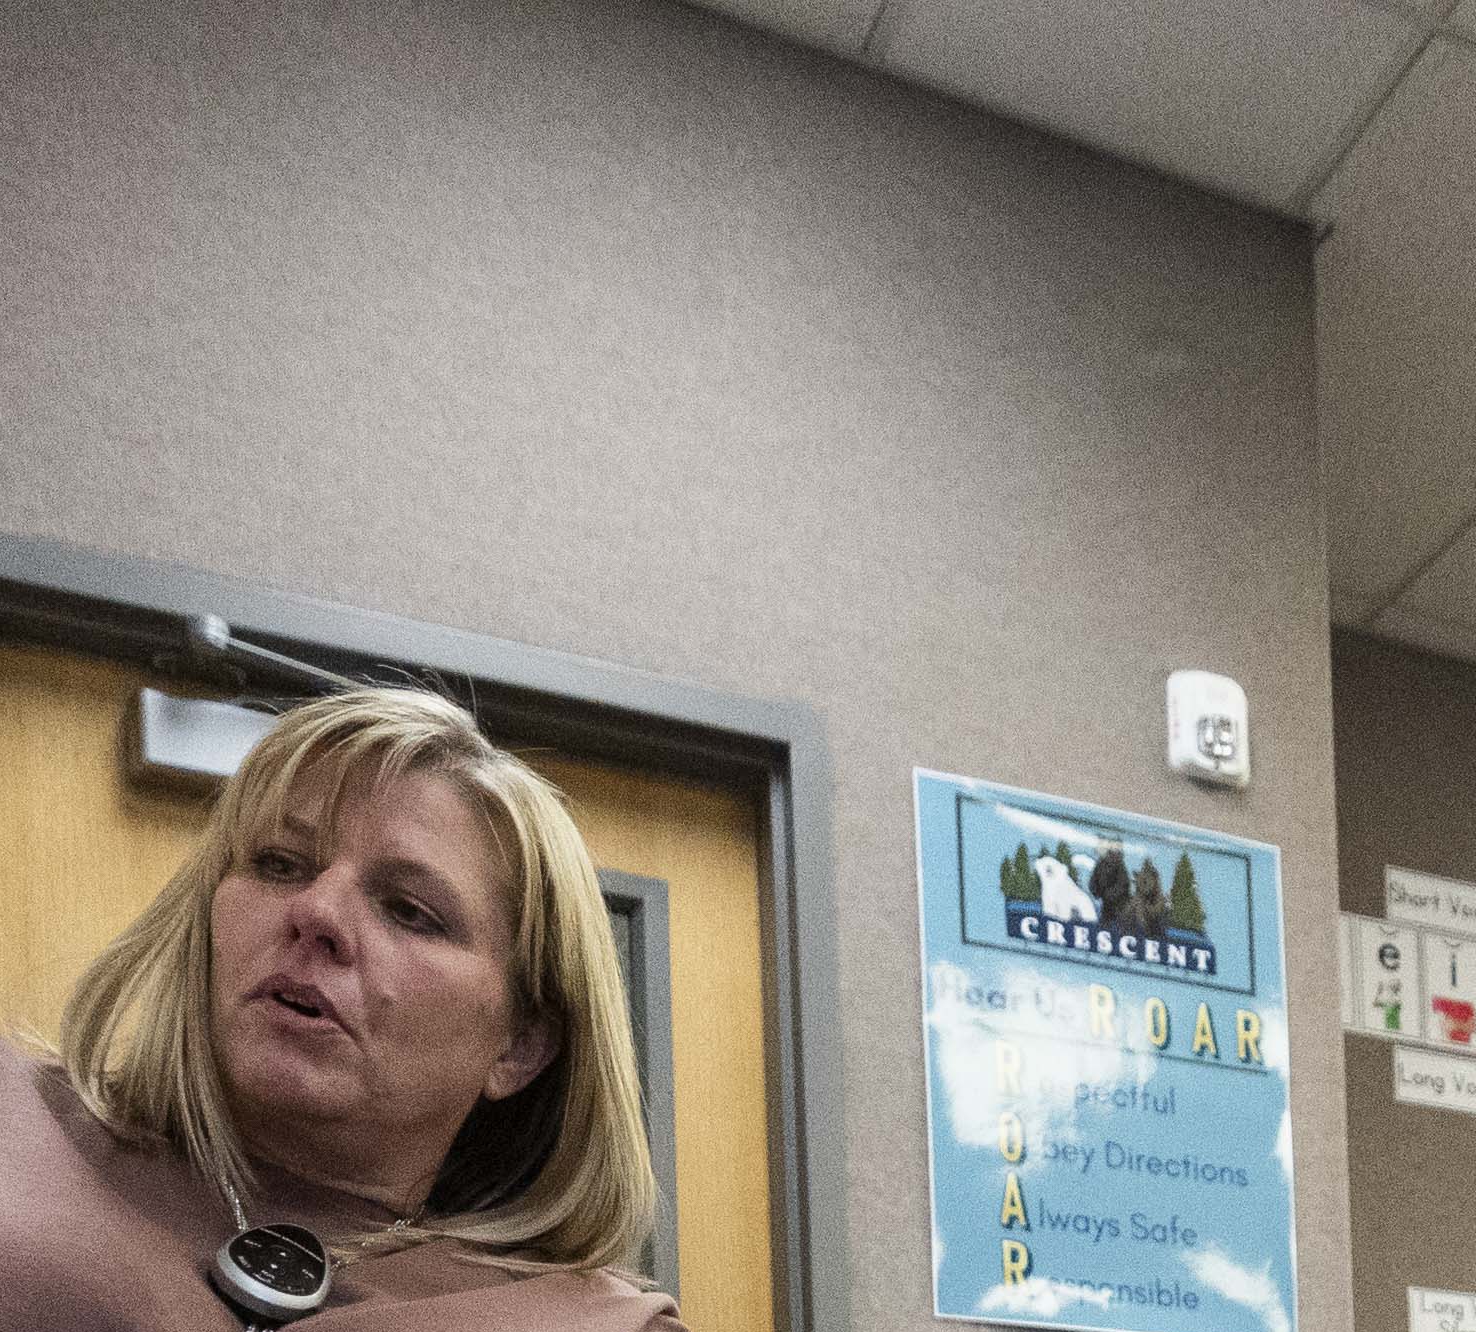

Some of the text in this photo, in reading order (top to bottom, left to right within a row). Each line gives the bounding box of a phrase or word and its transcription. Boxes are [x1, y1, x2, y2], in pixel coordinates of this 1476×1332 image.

[1390, 882, 1440, 911] Short
[1020, 917, 1212, 971] CRESCENT
[1378, 943, 1401, 971] e
[1088, 984, 1264, 1064] ROAR
[1398, 1063, 1446, 1095] Long
[1104, 1140, 1250, 1187] Directions
[1130, 1212, 1198, 1246] Safe
[1420, 1291, 1465, 1322] Long
